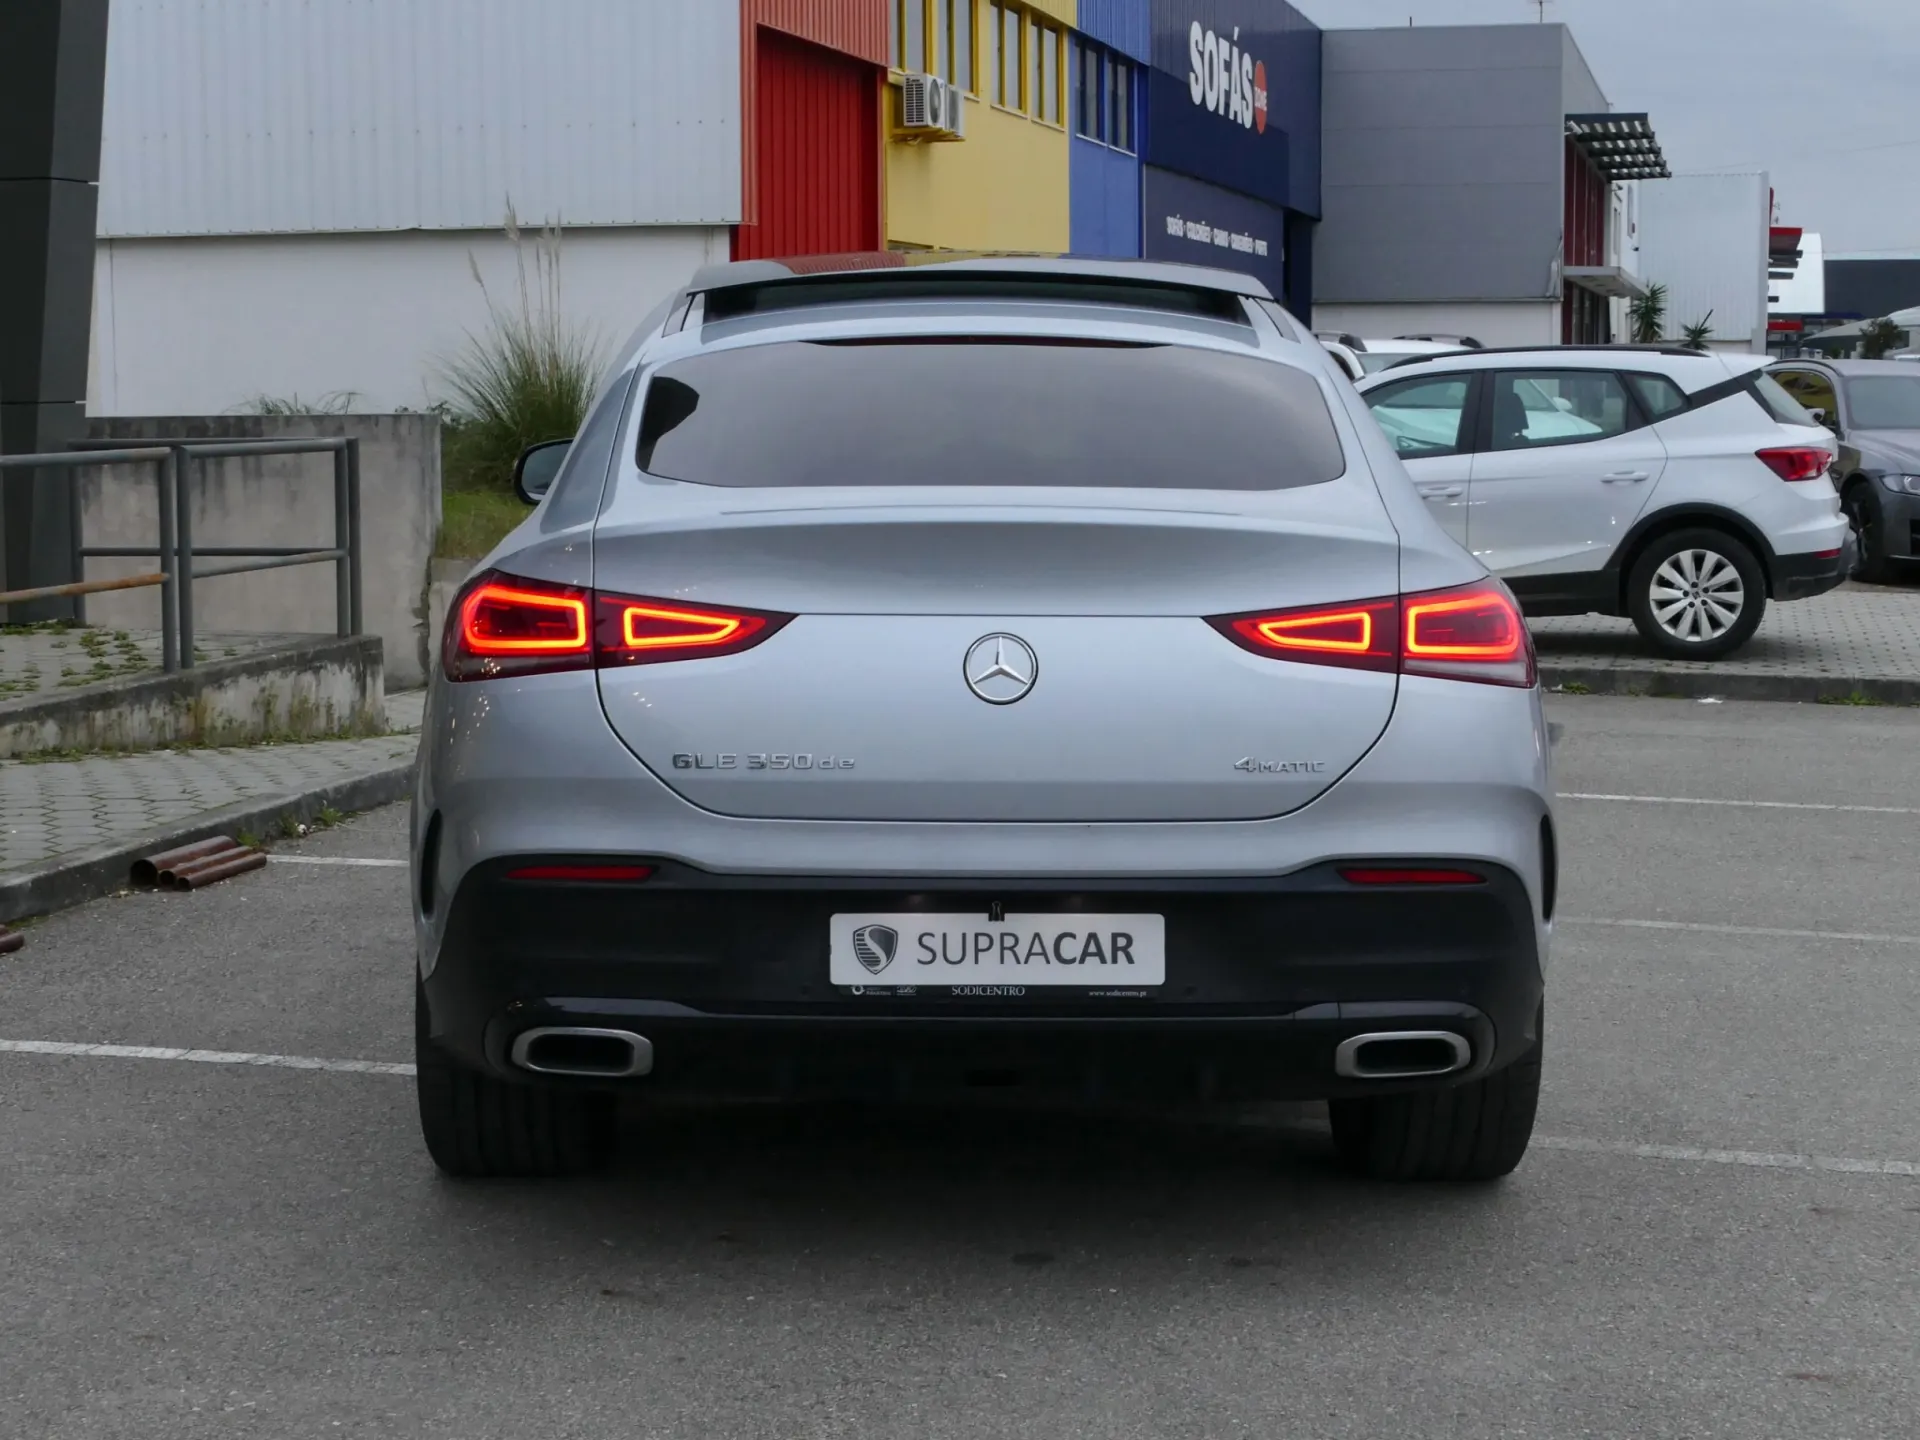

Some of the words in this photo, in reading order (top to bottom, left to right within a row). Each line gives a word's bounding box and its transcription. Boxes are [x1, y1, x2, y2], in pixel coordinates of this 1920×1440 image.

[1190, 20, 1253, 129] SOFÁS
[672, 752, 738, 770] GLE
[1234, 756, 1326, 773] 4MATIC
[916, 931, 1135, 966] SUPRACAR
[951, 985, 1026, 996] SODICENTRO
